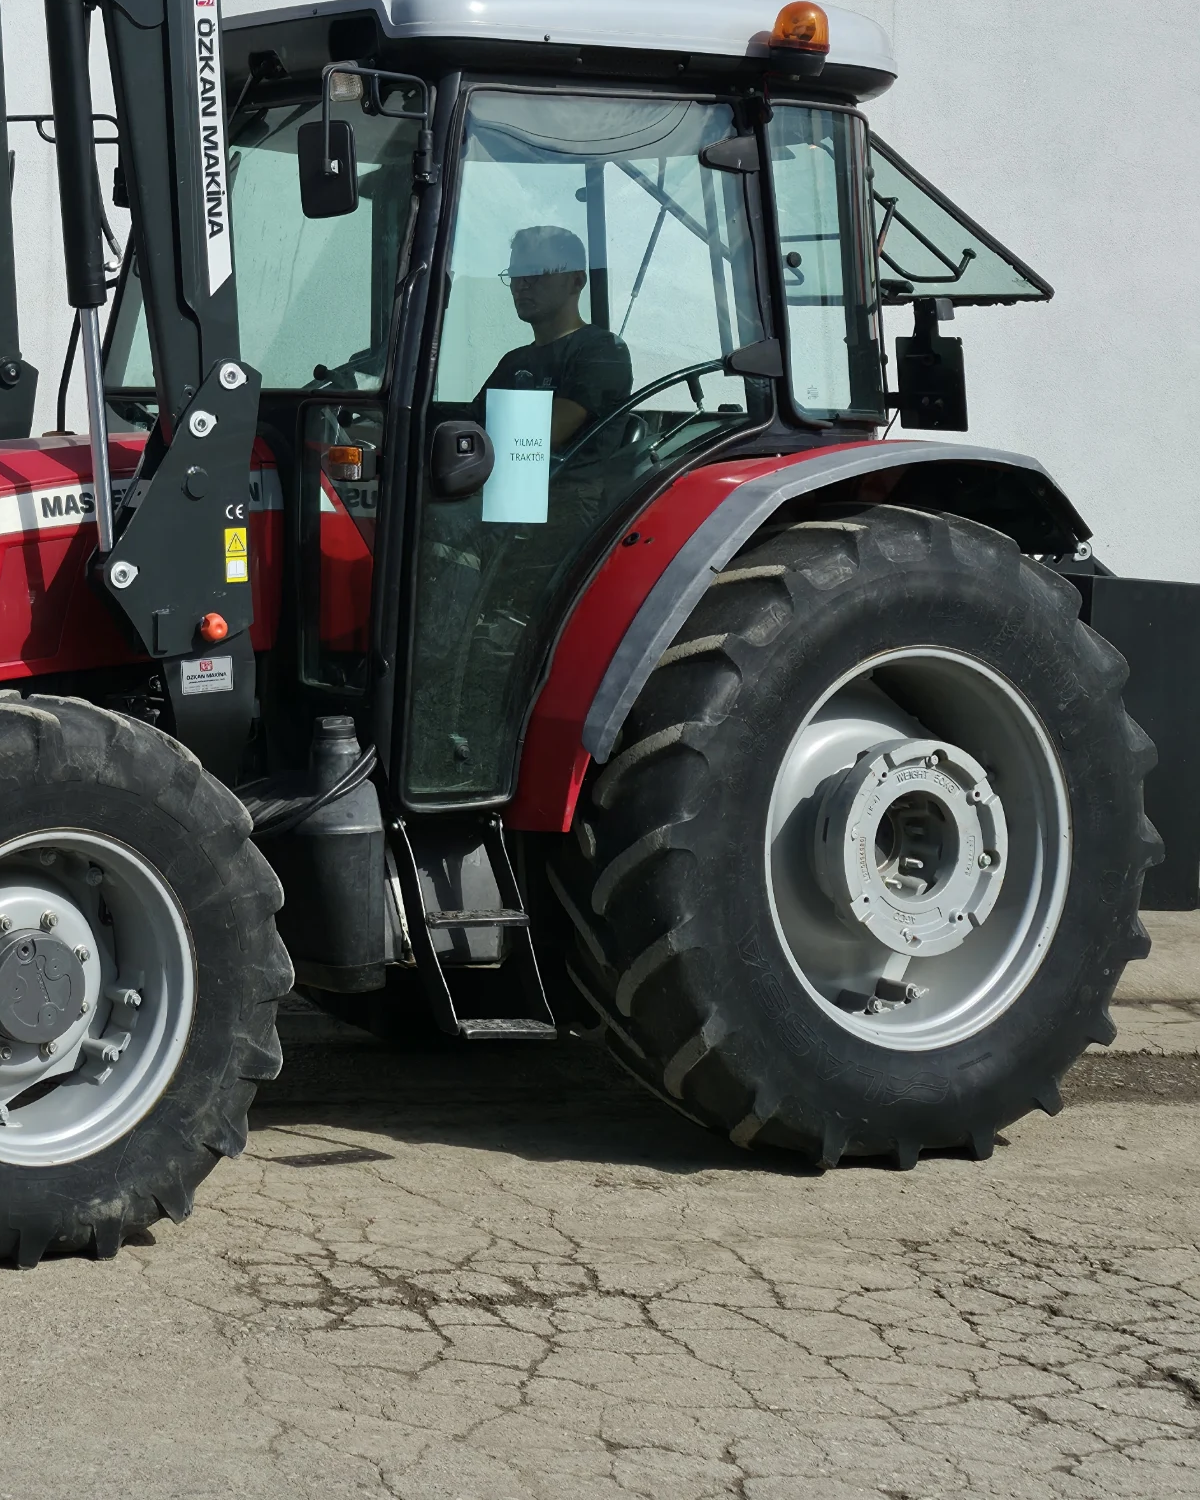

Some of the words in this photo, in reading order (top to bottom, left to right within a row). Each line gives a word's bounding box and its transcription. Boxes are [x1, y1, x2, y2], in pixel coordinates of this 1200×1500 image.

[197, 18, 218, 118] ÖZKAN
[202, 125, 226, 239] MAKİNA
[514, 438, 543, 447] YILMAZ
[510, 452, 545, 462] TRAKTÖR
[225, 504, 244, 519] CE
[896, 769, 929, 783] WEIGHT
[737, 924, 886, 1101] LASSA
